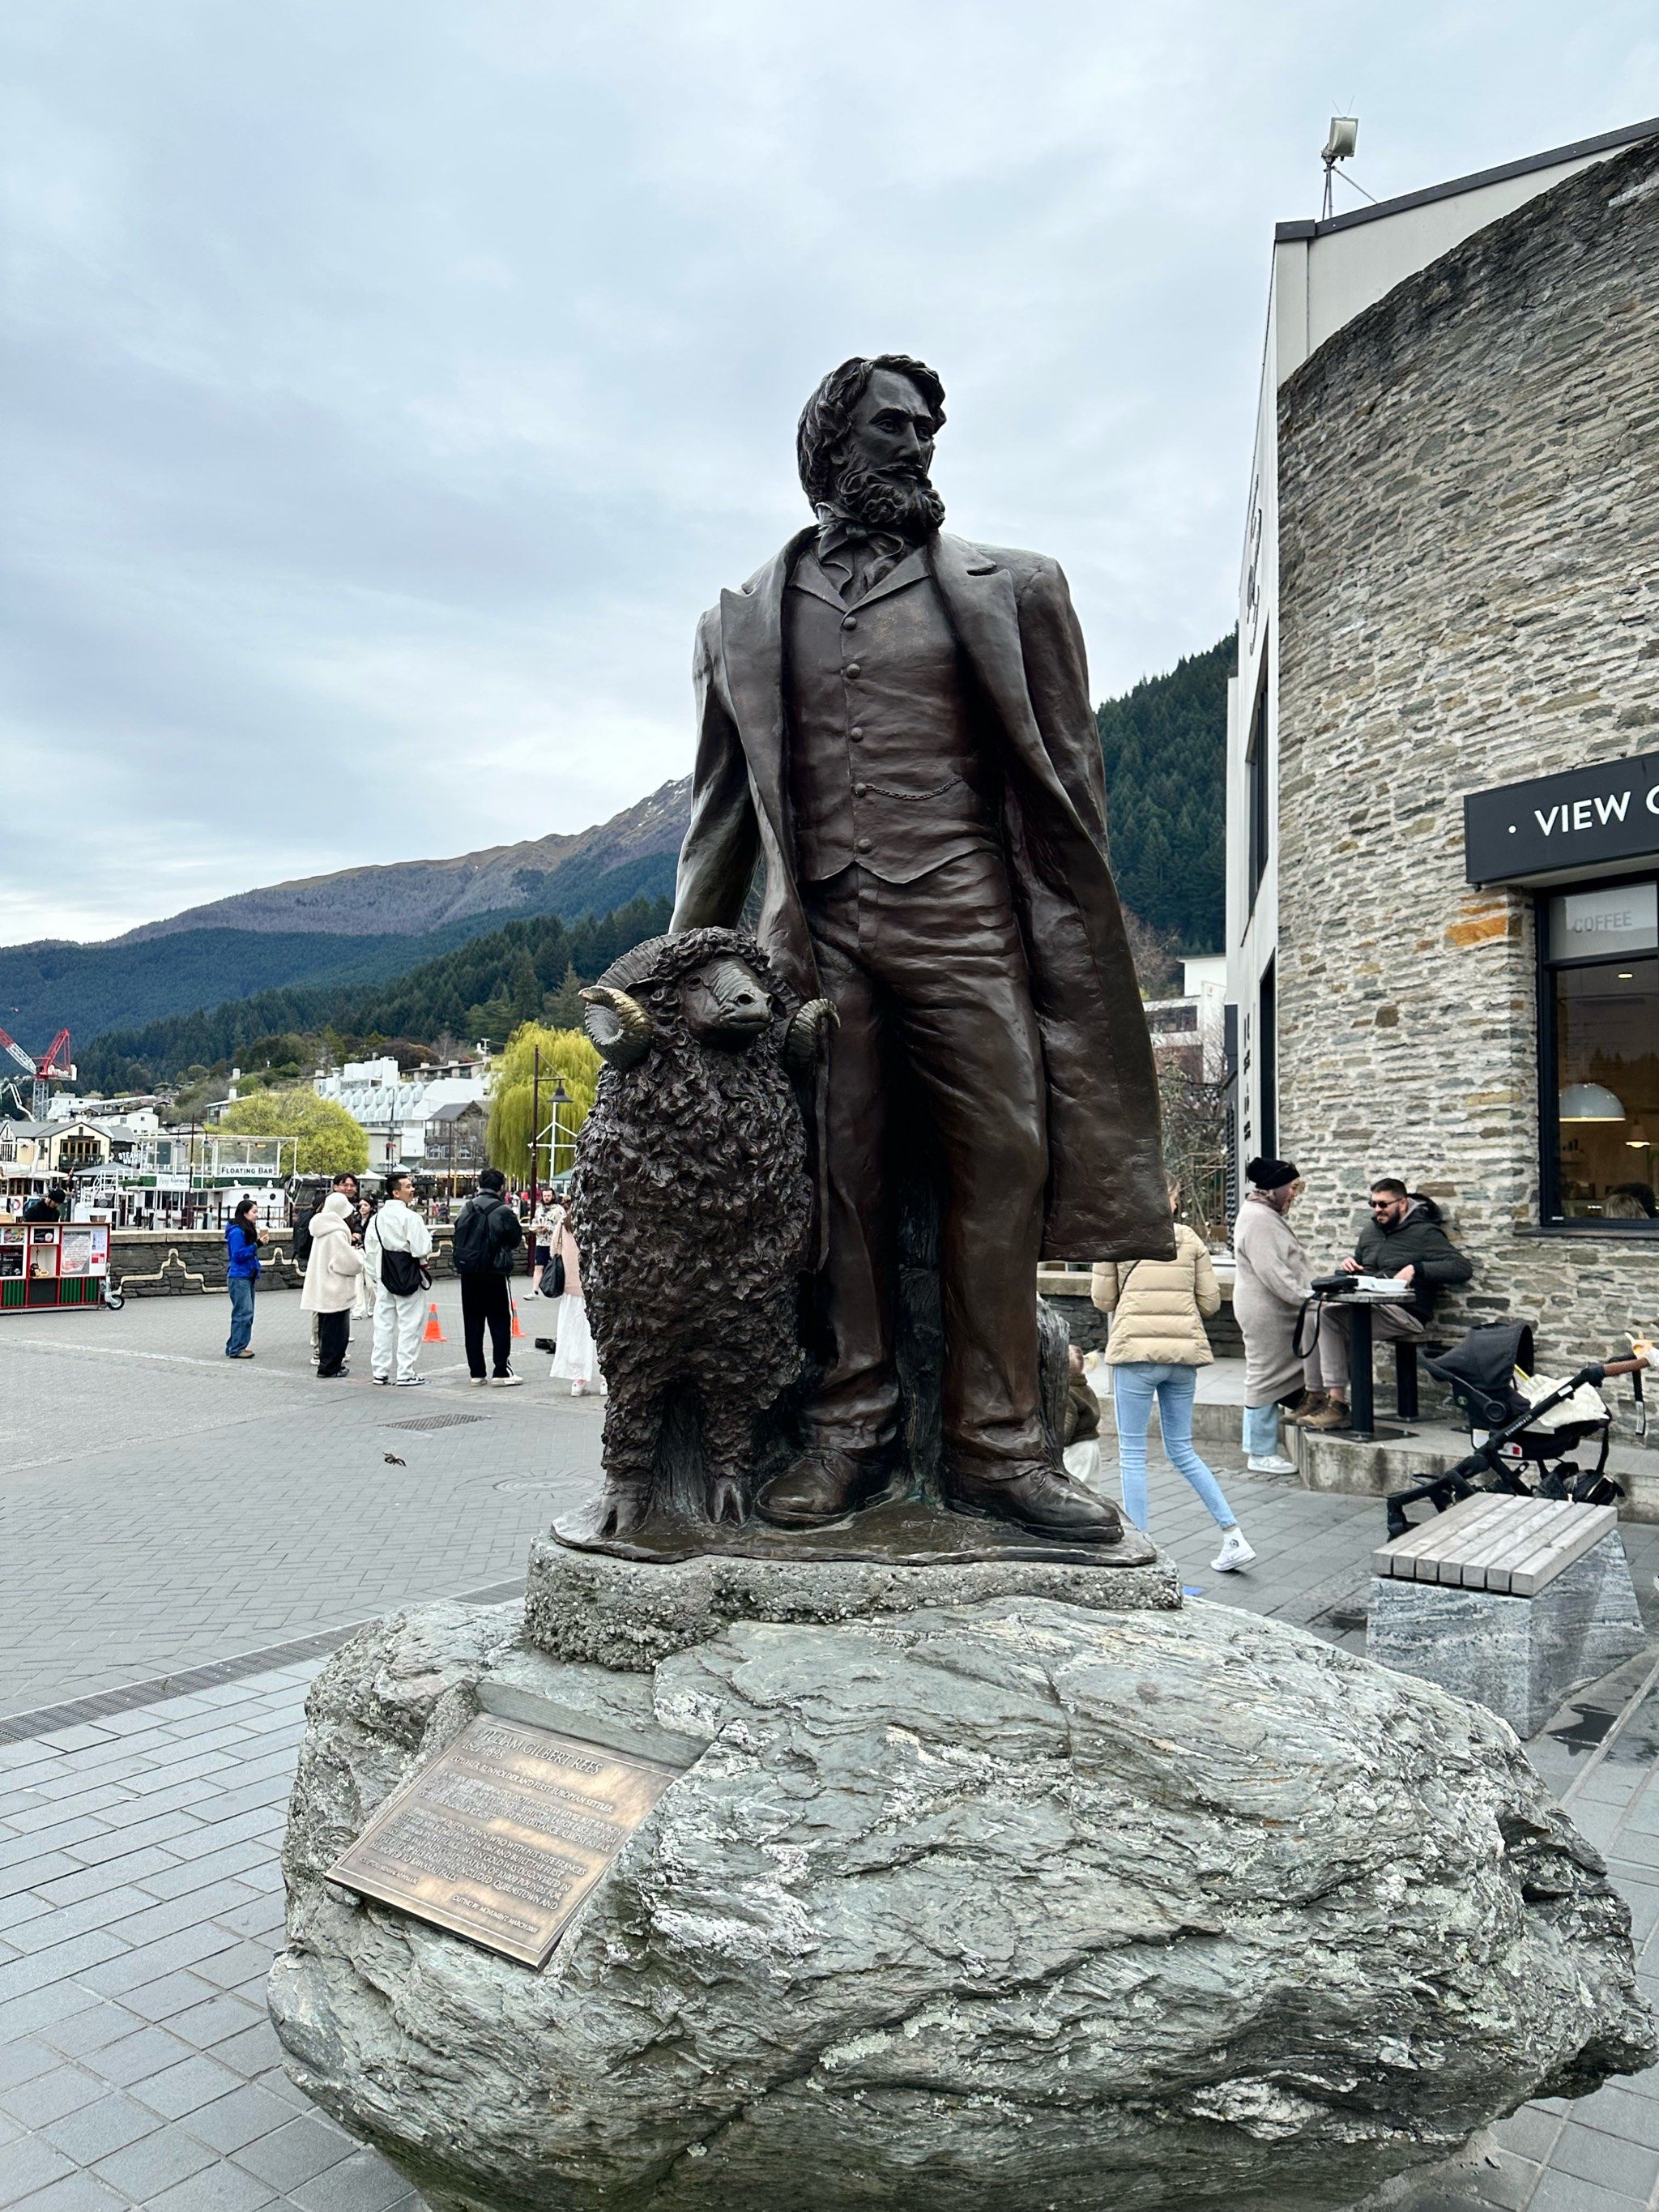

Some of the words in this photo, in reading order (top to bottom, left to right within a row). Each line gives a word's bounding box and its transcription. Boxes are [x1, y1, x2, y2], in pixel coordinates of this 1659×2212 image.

[1534, 791, 1631, 837] VIEW
[1573, 910, 1633, 933] COFFEE
[471, 1727, 526, 1750] WILLIAM
[520, 1742, 574, 1766] GILBERT
[569, 1757, 603, 1774] REES
[516, 1777, 535, 1786] AND
[532, 1782, 552, 1792] FIRST
[549, 1787, 586, 1803] EUROPEAN
[512, 1813, 528, 1823] THE
[550, 1817, 574, 1828] LARGE
[400, 1854, 412, 1862] TO
[461, 1846, 486, 1859] WHEN
[482, 1854, 505, 1866] GOLD
[501, 1861, 519, 1872] WAS
[516, 1866, 562, 1887] DISCOVERED
[559, 1882, 572, 1891] IN
[472, 1839, 484, 1847] IN
[494, 1847, 512, 1858] AND
[510, 1853, 531, 1865] BUILT
[527, 1860, 546, 1870] THE
[543, 1865, 565, 1877] FIRST
[488, 1835, 508, 1846] WHO
[505, 1841, 527, 1853] WITH
[525, 1848, 539, 1857] HIS
[536, 1852, 557, 1864] WIFE
[554, 1859, 587, 1875] FRANCES
[456, 1865, 494, 1884] INCLUDED
[491, 1879, 543, 1902] QUEENSTOWN
[539, 1897, 561, 1910] AND
[486, 1866, 500, 1875] OF
[516, 1877, 548, 1894] POUNDS
[545, 1888, 564, 1899] FOR
